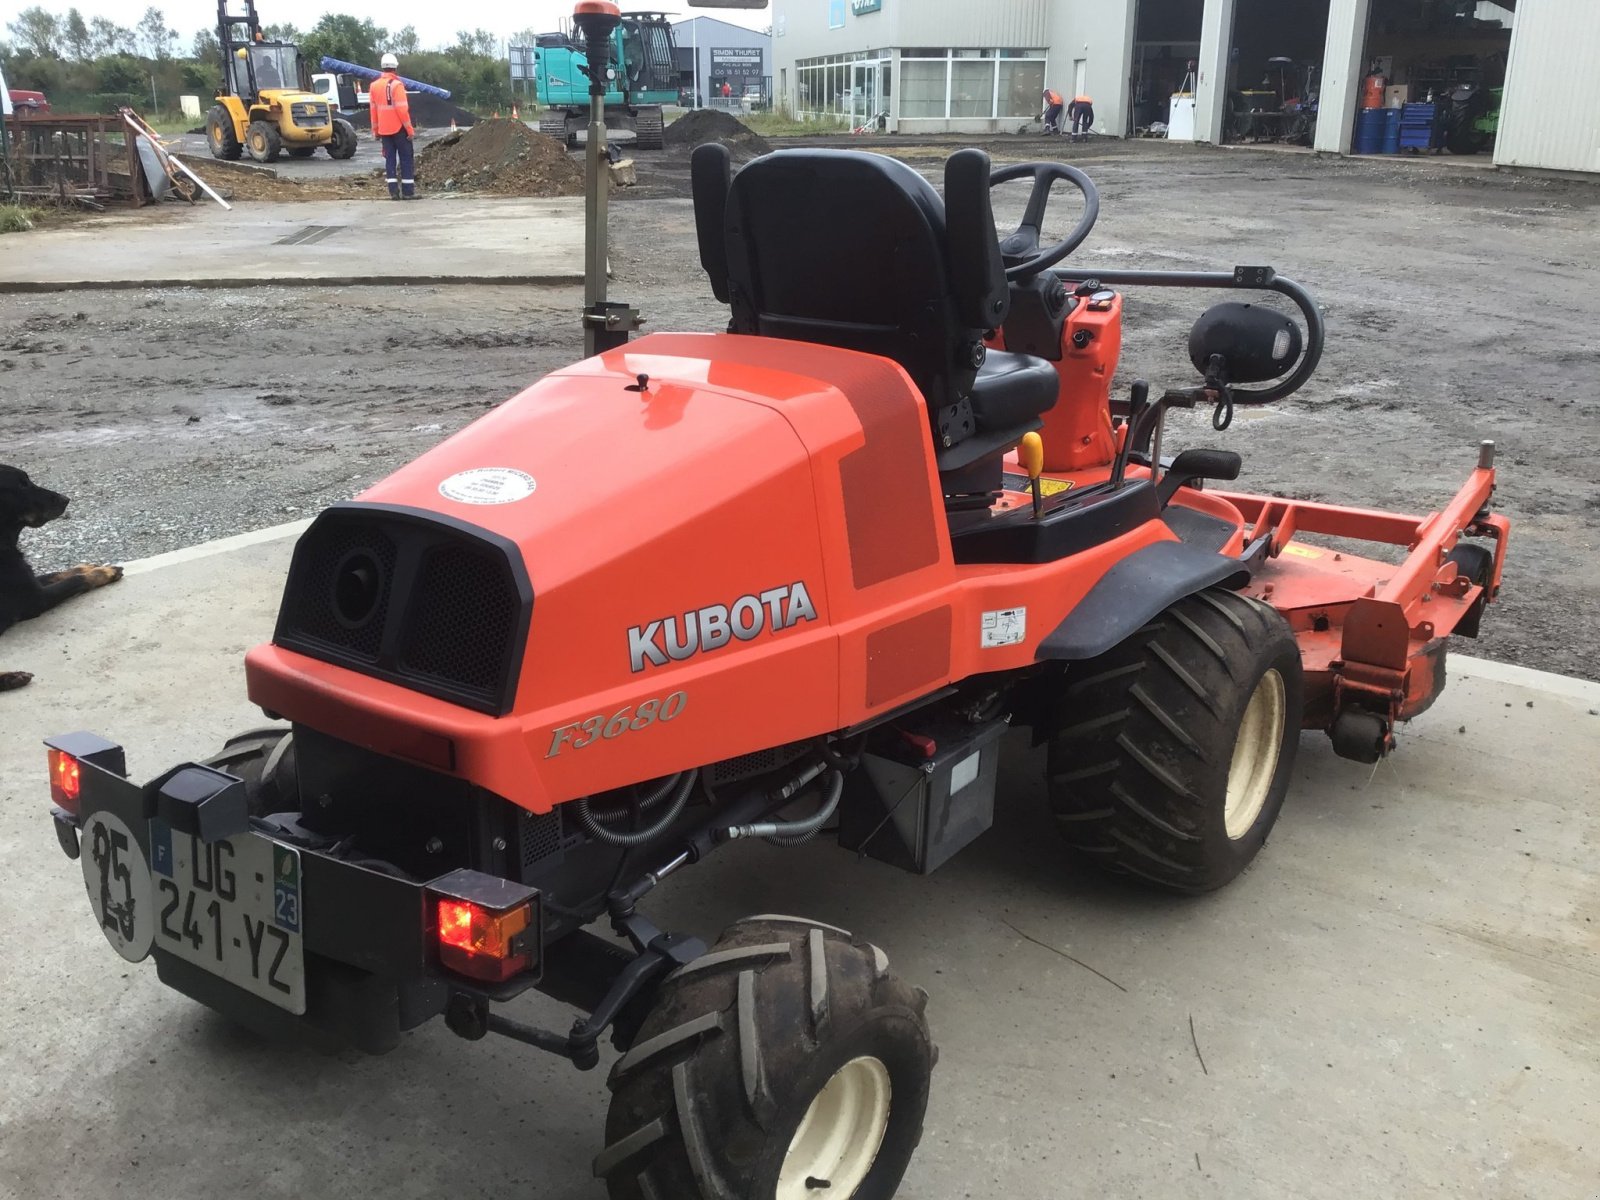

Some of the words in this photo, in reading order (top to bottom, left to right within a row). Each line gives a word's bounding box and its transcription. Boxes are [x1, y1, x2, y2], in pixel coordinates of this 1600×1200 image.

[627, 581, 818, 673] KUBOTA
[543, 690, 688, 760] F3680
[92, 821, 136, 943] 25
[158, 845, 166, 862] F
[276, 888, 298, 926] 23
